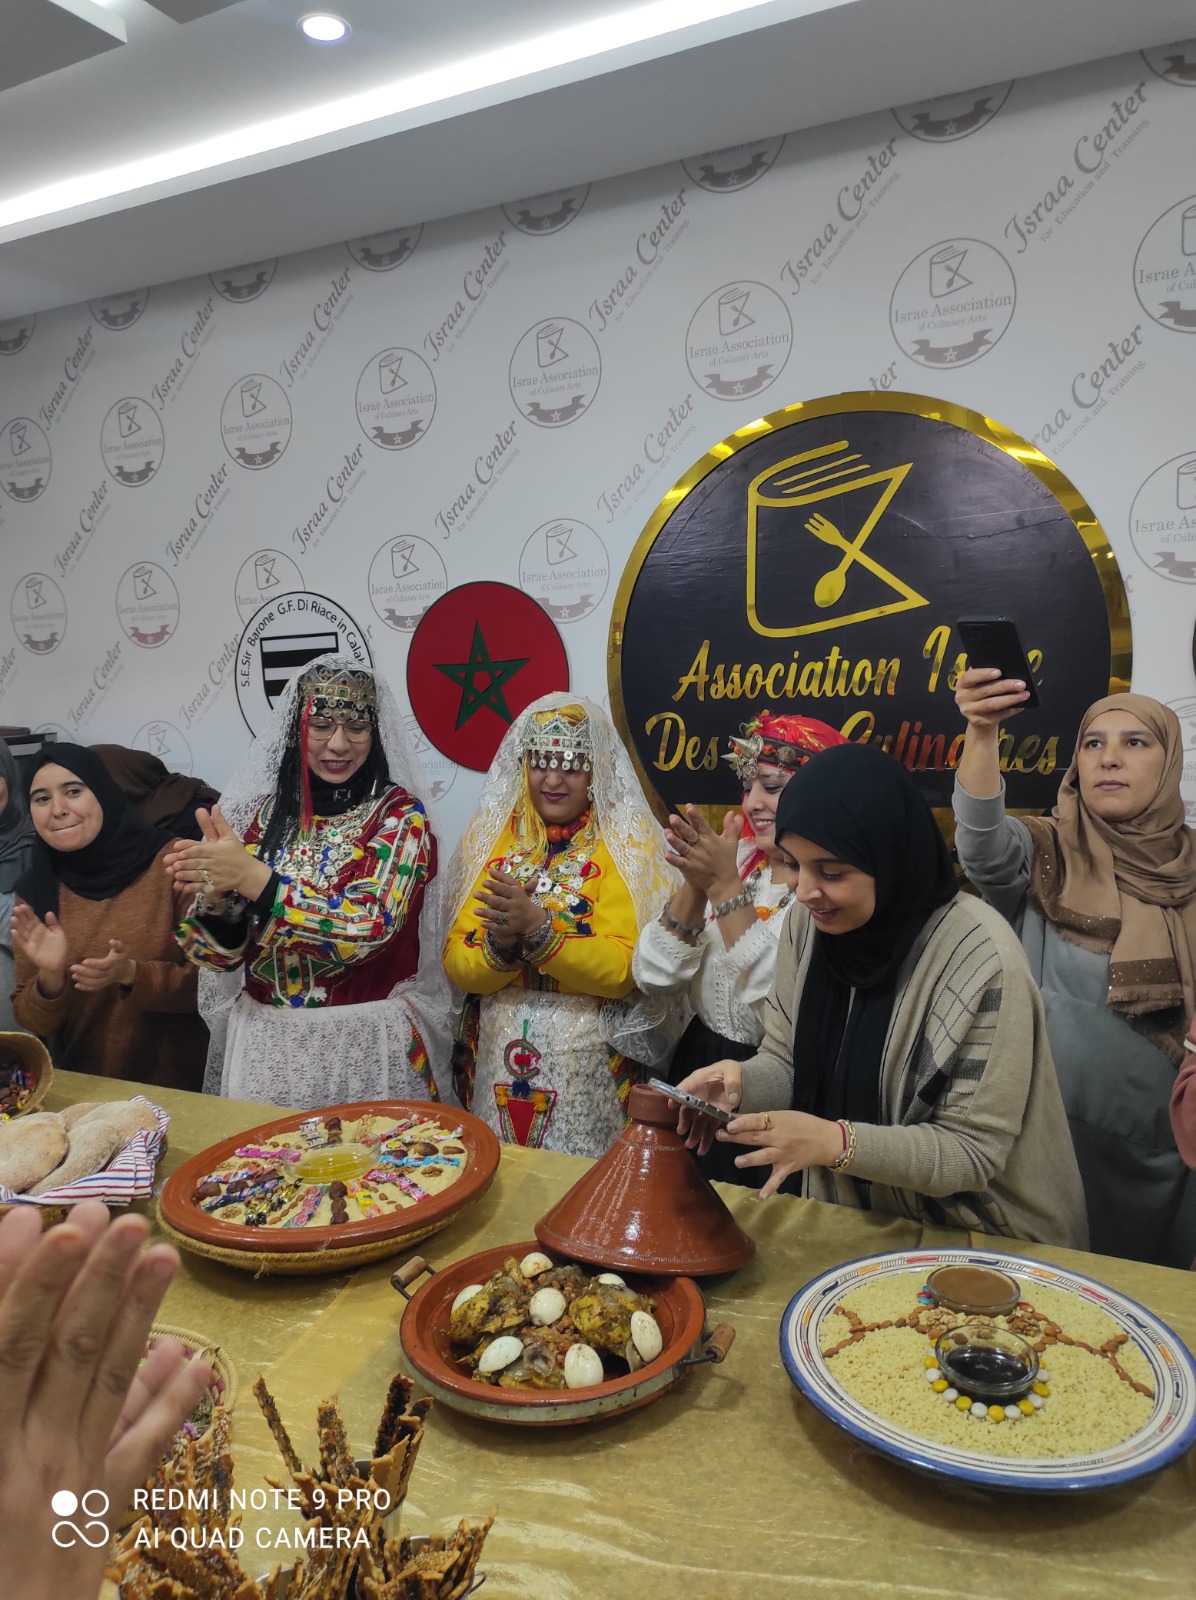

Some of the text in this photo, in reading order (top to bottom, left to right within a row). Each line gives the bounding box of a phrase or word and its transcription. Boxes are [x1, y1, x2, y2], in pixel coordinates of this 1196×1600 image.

[1004, 81, 1147, 254] Israa Center
[1040, 119, 1150, 242] for Education and Training
[780, 137, 897, 295] Israa Center
[589, 188, 687, 332] Israa Center
[1138, 268, 1179, 284] Israe
[423, 230, 508, 362] Israa Center
[894, 294, 1012, 323] Israe Association
[917, 314, 988, 332] of Culinary Arts
[152, 358, 184, 410] Israa
[181, 299, 214, 359] Center
[279, 267, 352, 388] Israa Center
[689, 332, 790, 359] Israe Association
[512, 365, 599, 389] Israe Association
[709, 357, 717, 367] of
[1030, 324, 1142, 448] raa Center
[1106, 360, 1147, 397] Training
[223, 417, 291, 436] Israe Association
[358, 392, 434, 413] Israe Association
[434, 420, 517, 540] Israa Center
[596, 393, 694, 524] Israa Center
[165, 462, 228, 567] Israa Center
[292, 443, 364, 555] Israa Center
[1134, 518, 1175, 533] Israe
[371, 579, 445, 595] Israe Association
[522, 566, 607, 583] Israe Association
[246, 612, 275, 647] Barone
[277, 600, 296, 615] G.F.
[297, 598, 309, 611] Di
[310, 600, 337, 624] Riace
[336, 618, 348, 634] in
[178, 683, 210, 730] Israa
[208, 633, 240, 686] Center
[671, 639, 900, 701] Association
[645, 711, 719, 772] Des
